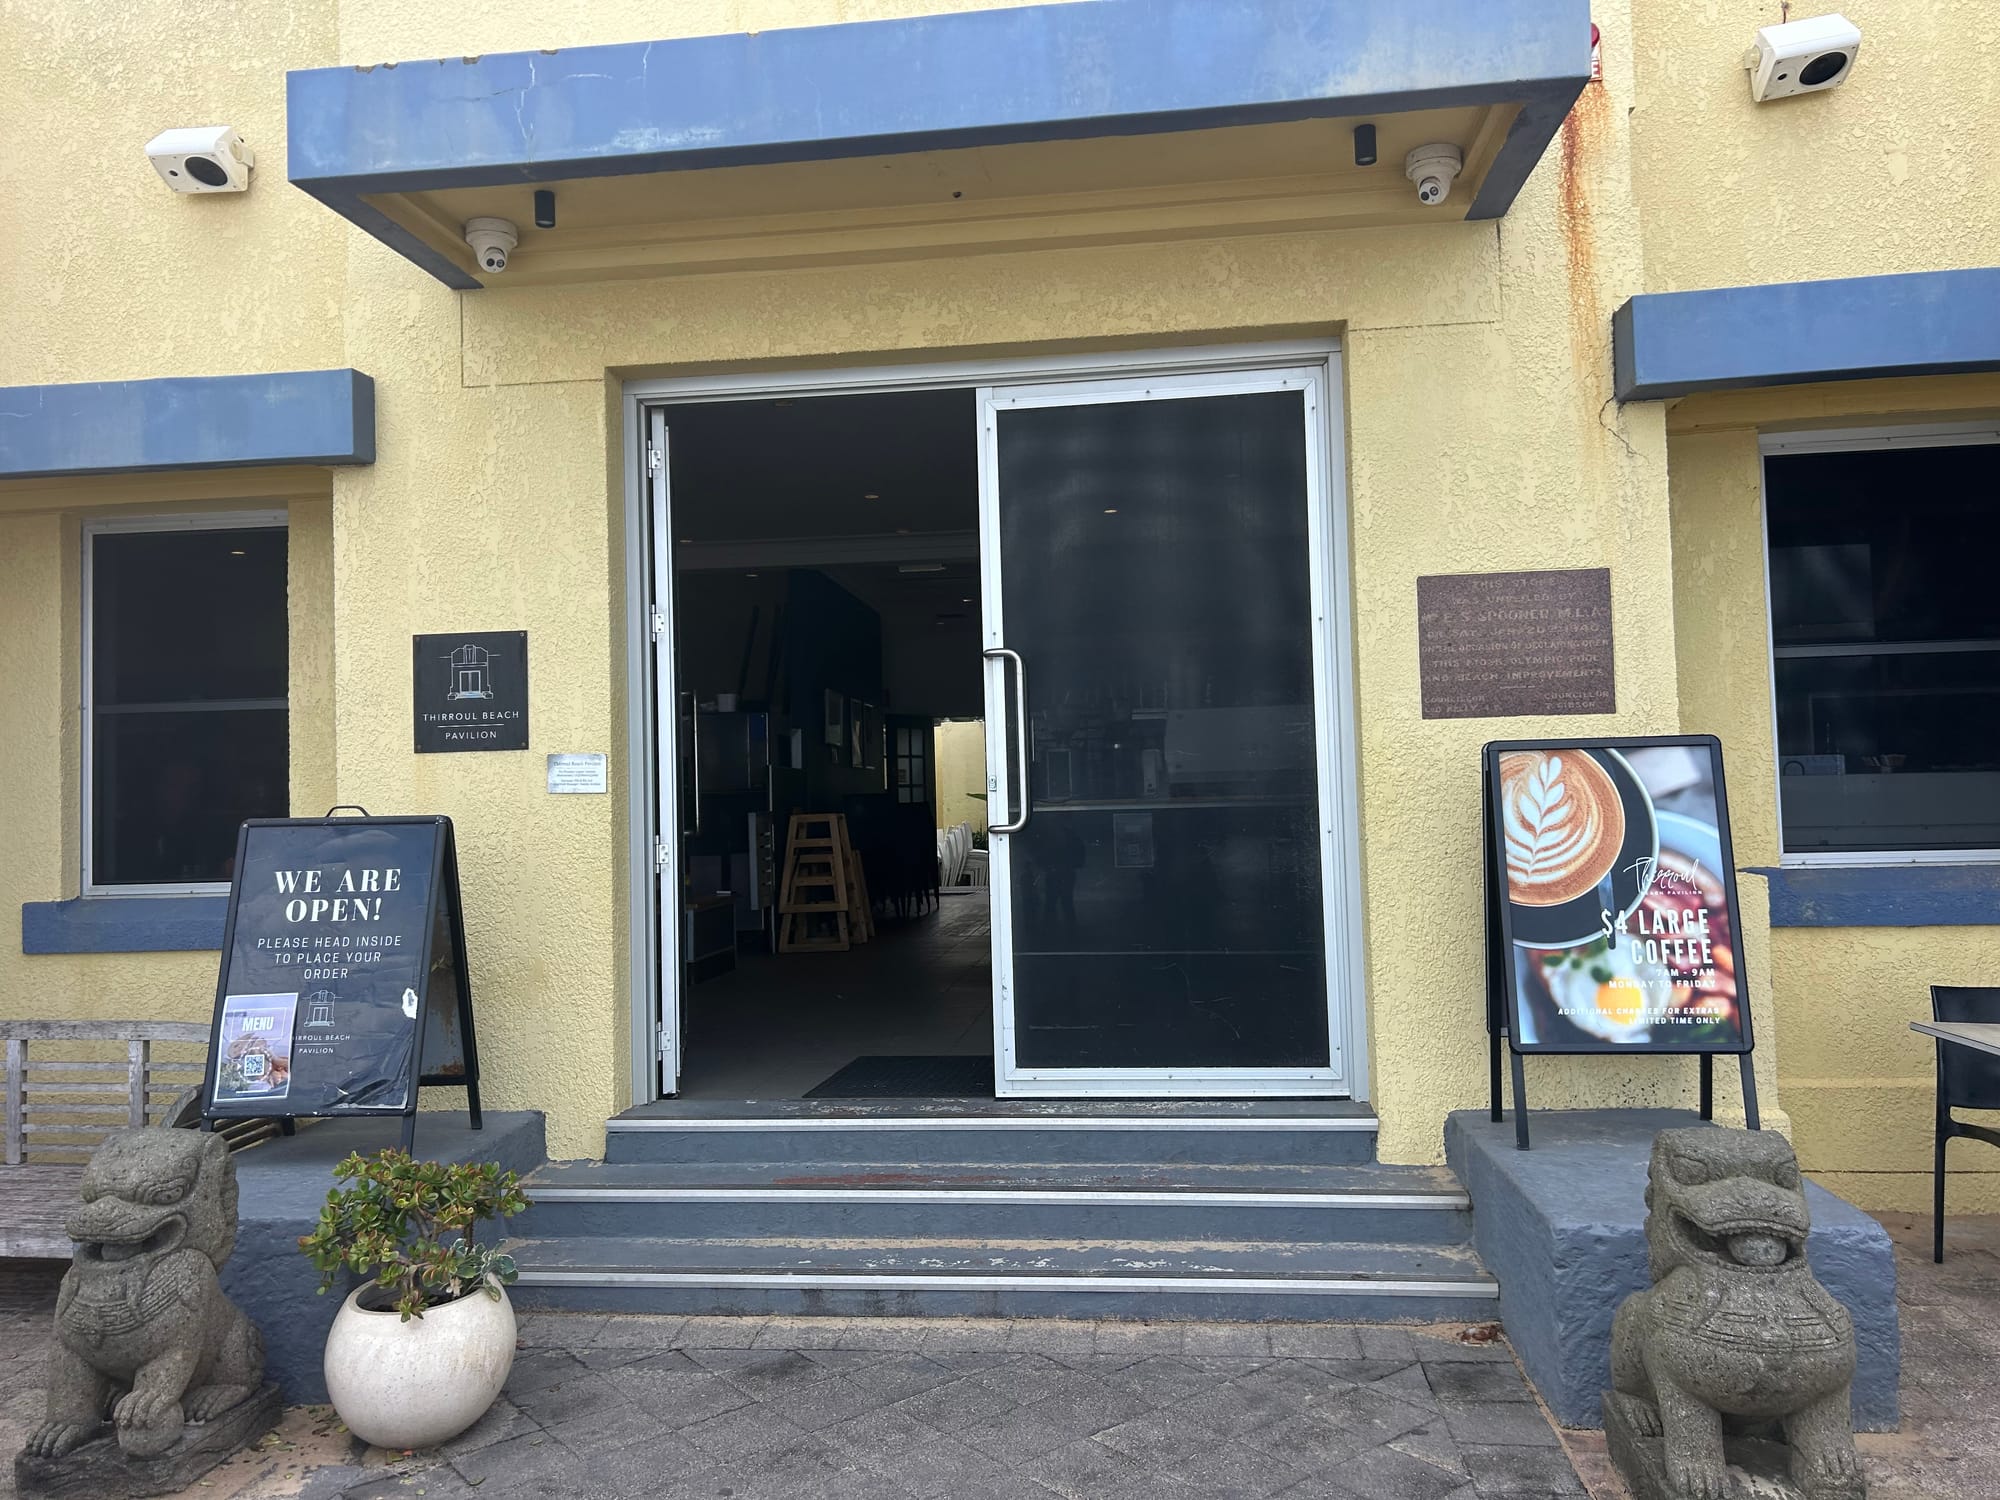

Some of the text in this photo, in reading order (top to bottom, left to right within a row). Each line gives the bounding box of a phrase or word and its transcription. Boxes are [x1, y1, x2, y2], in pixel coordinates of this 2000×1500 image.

[423, 710, 520, 722] THIRROUL BEACH
[445, 730, 498, 740] PAVILION
[274, 868, 401, 894] WE ARE
[285, 897, 382, 923] OPEN!
[1601, 908, 1710, 938] $4 LARGE
[257, 935, 402, 949] PLEASE HEAD INSIDE
[275, 951, 381, 964] TO PLACE YOUR
[1631, 938, 1713, 965] COFFEE
[304, 968, 348, 980] ORDER
[1656, 968, 1680, 978] 7AM
[1691, 968, 1716, 977] 9AM
[1608, 979, 1716, 989] MONAY TO FRIDAY
[1557, 1007, 1613, 1016] ADDITIONAL
[1662, 1007, 1681, 1015] FOR
[1683, 1006, 1721, 1015] EXTRAS
[242, 1015, 275, 1032] MENU
[1628, 1016, 1722, 1026] LMITED TIME ONLY
[325, 1033, 351, 1041] BEACH
